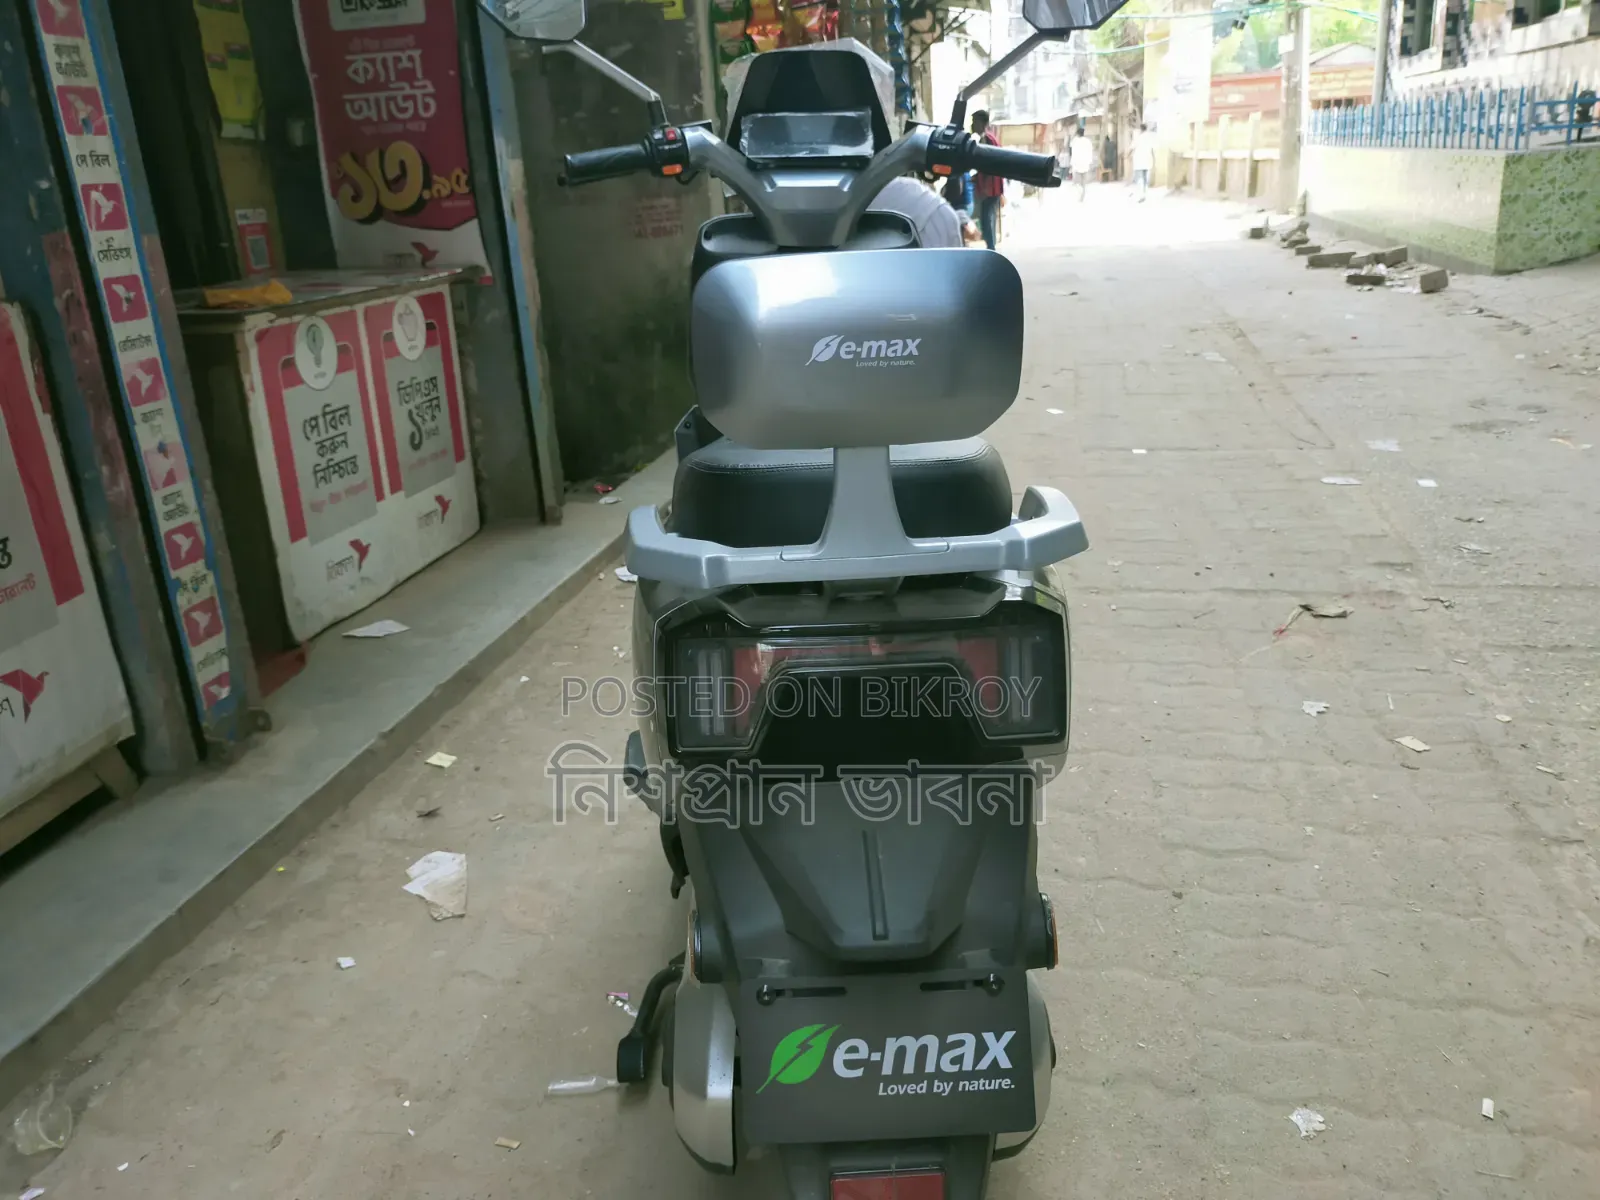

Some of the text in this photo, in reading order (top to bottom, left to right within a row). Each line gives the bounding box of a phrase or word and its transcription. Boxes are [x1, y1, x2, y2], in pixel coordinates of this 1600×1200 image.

[344, 49, 423, 84] ক্যাশ
[342, 79, 437, 121] আউট
[88, 150, 111, 167] বিল
[839, 338, 922, 360] e-max
[879, 359, 888, 367] by
[303, 403, 352, 441] পে বিল
[315, 431, 349, 457] করুন
[832, 1030, 1016, 1079] e-max
[877, 1078, 1015, 1096] Loved by nature.
